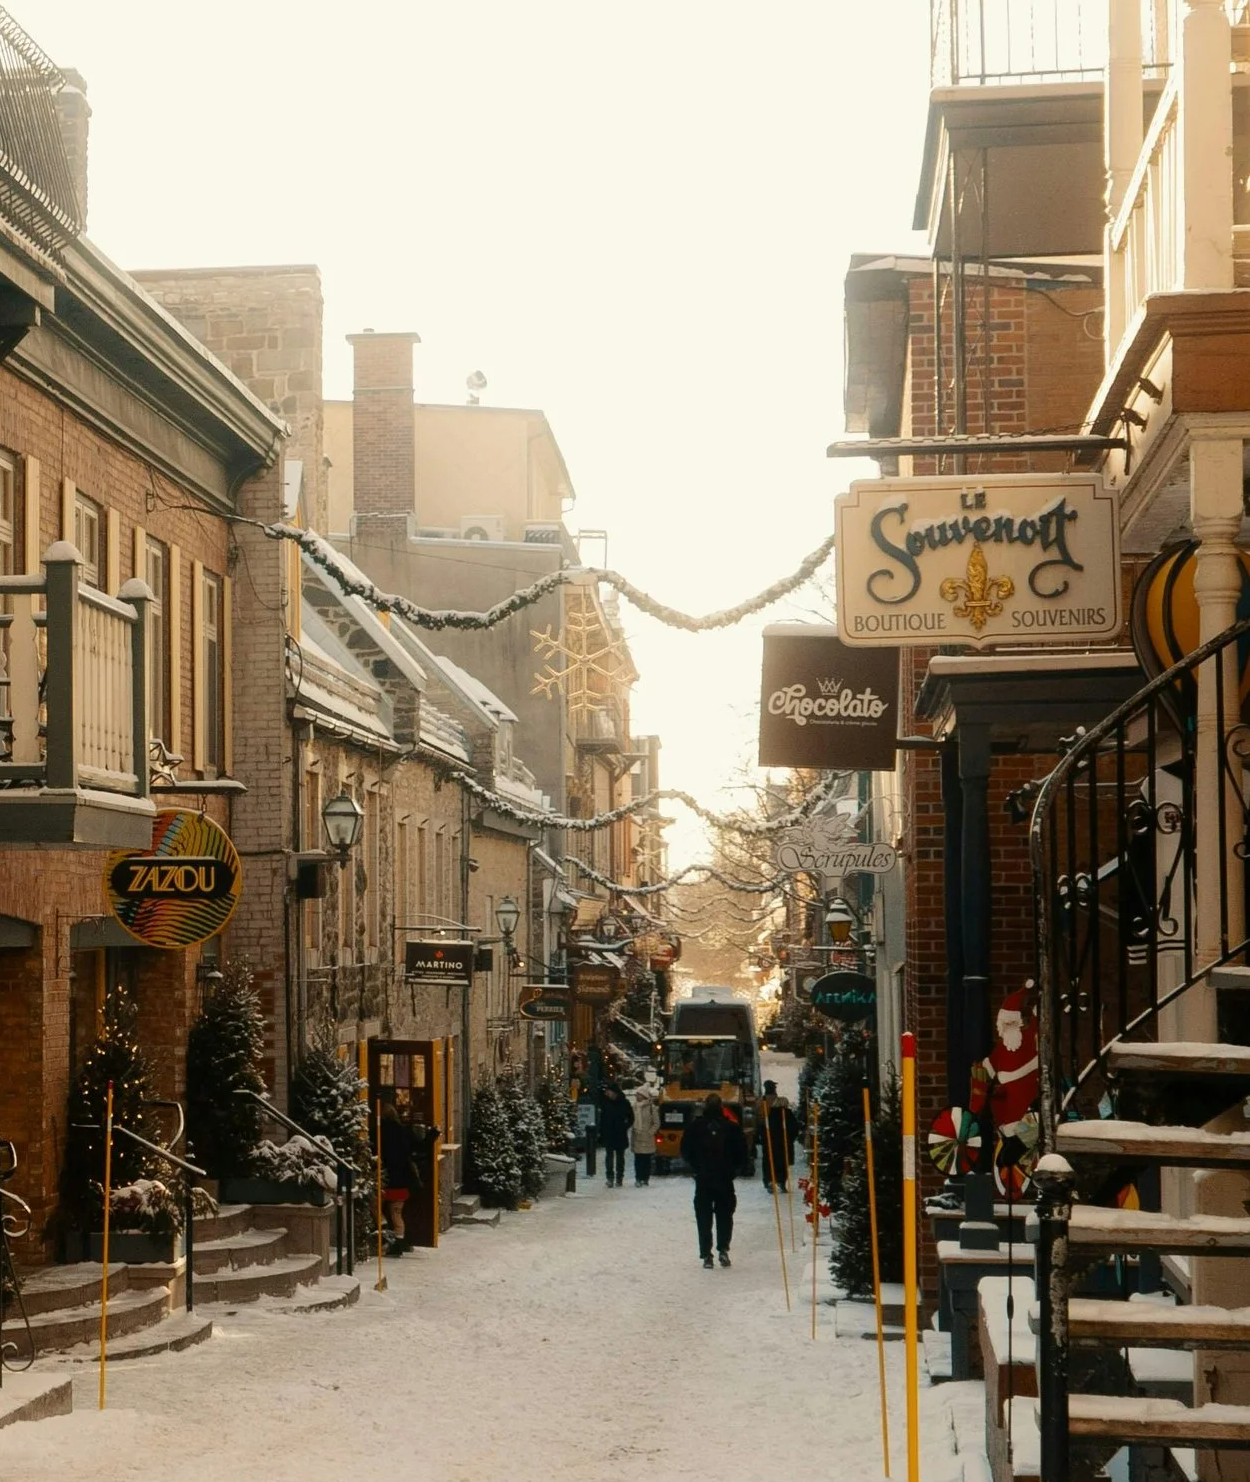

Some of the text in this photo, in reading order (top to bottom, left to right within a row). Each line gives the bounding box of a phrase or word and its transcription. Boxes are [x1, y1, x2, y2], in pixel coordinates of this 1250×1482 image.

[960, 490, 987, 509] LE
[853, 607, 1107, 633] BOUTIQUE SOUVENIRS
[768, 683, 889, 726] Chocolato
[780, 845, 892, 875] Scrupules
[127, 865, 215, 892] ZAZOU
[415, 960, 463, 970] MARTINO
